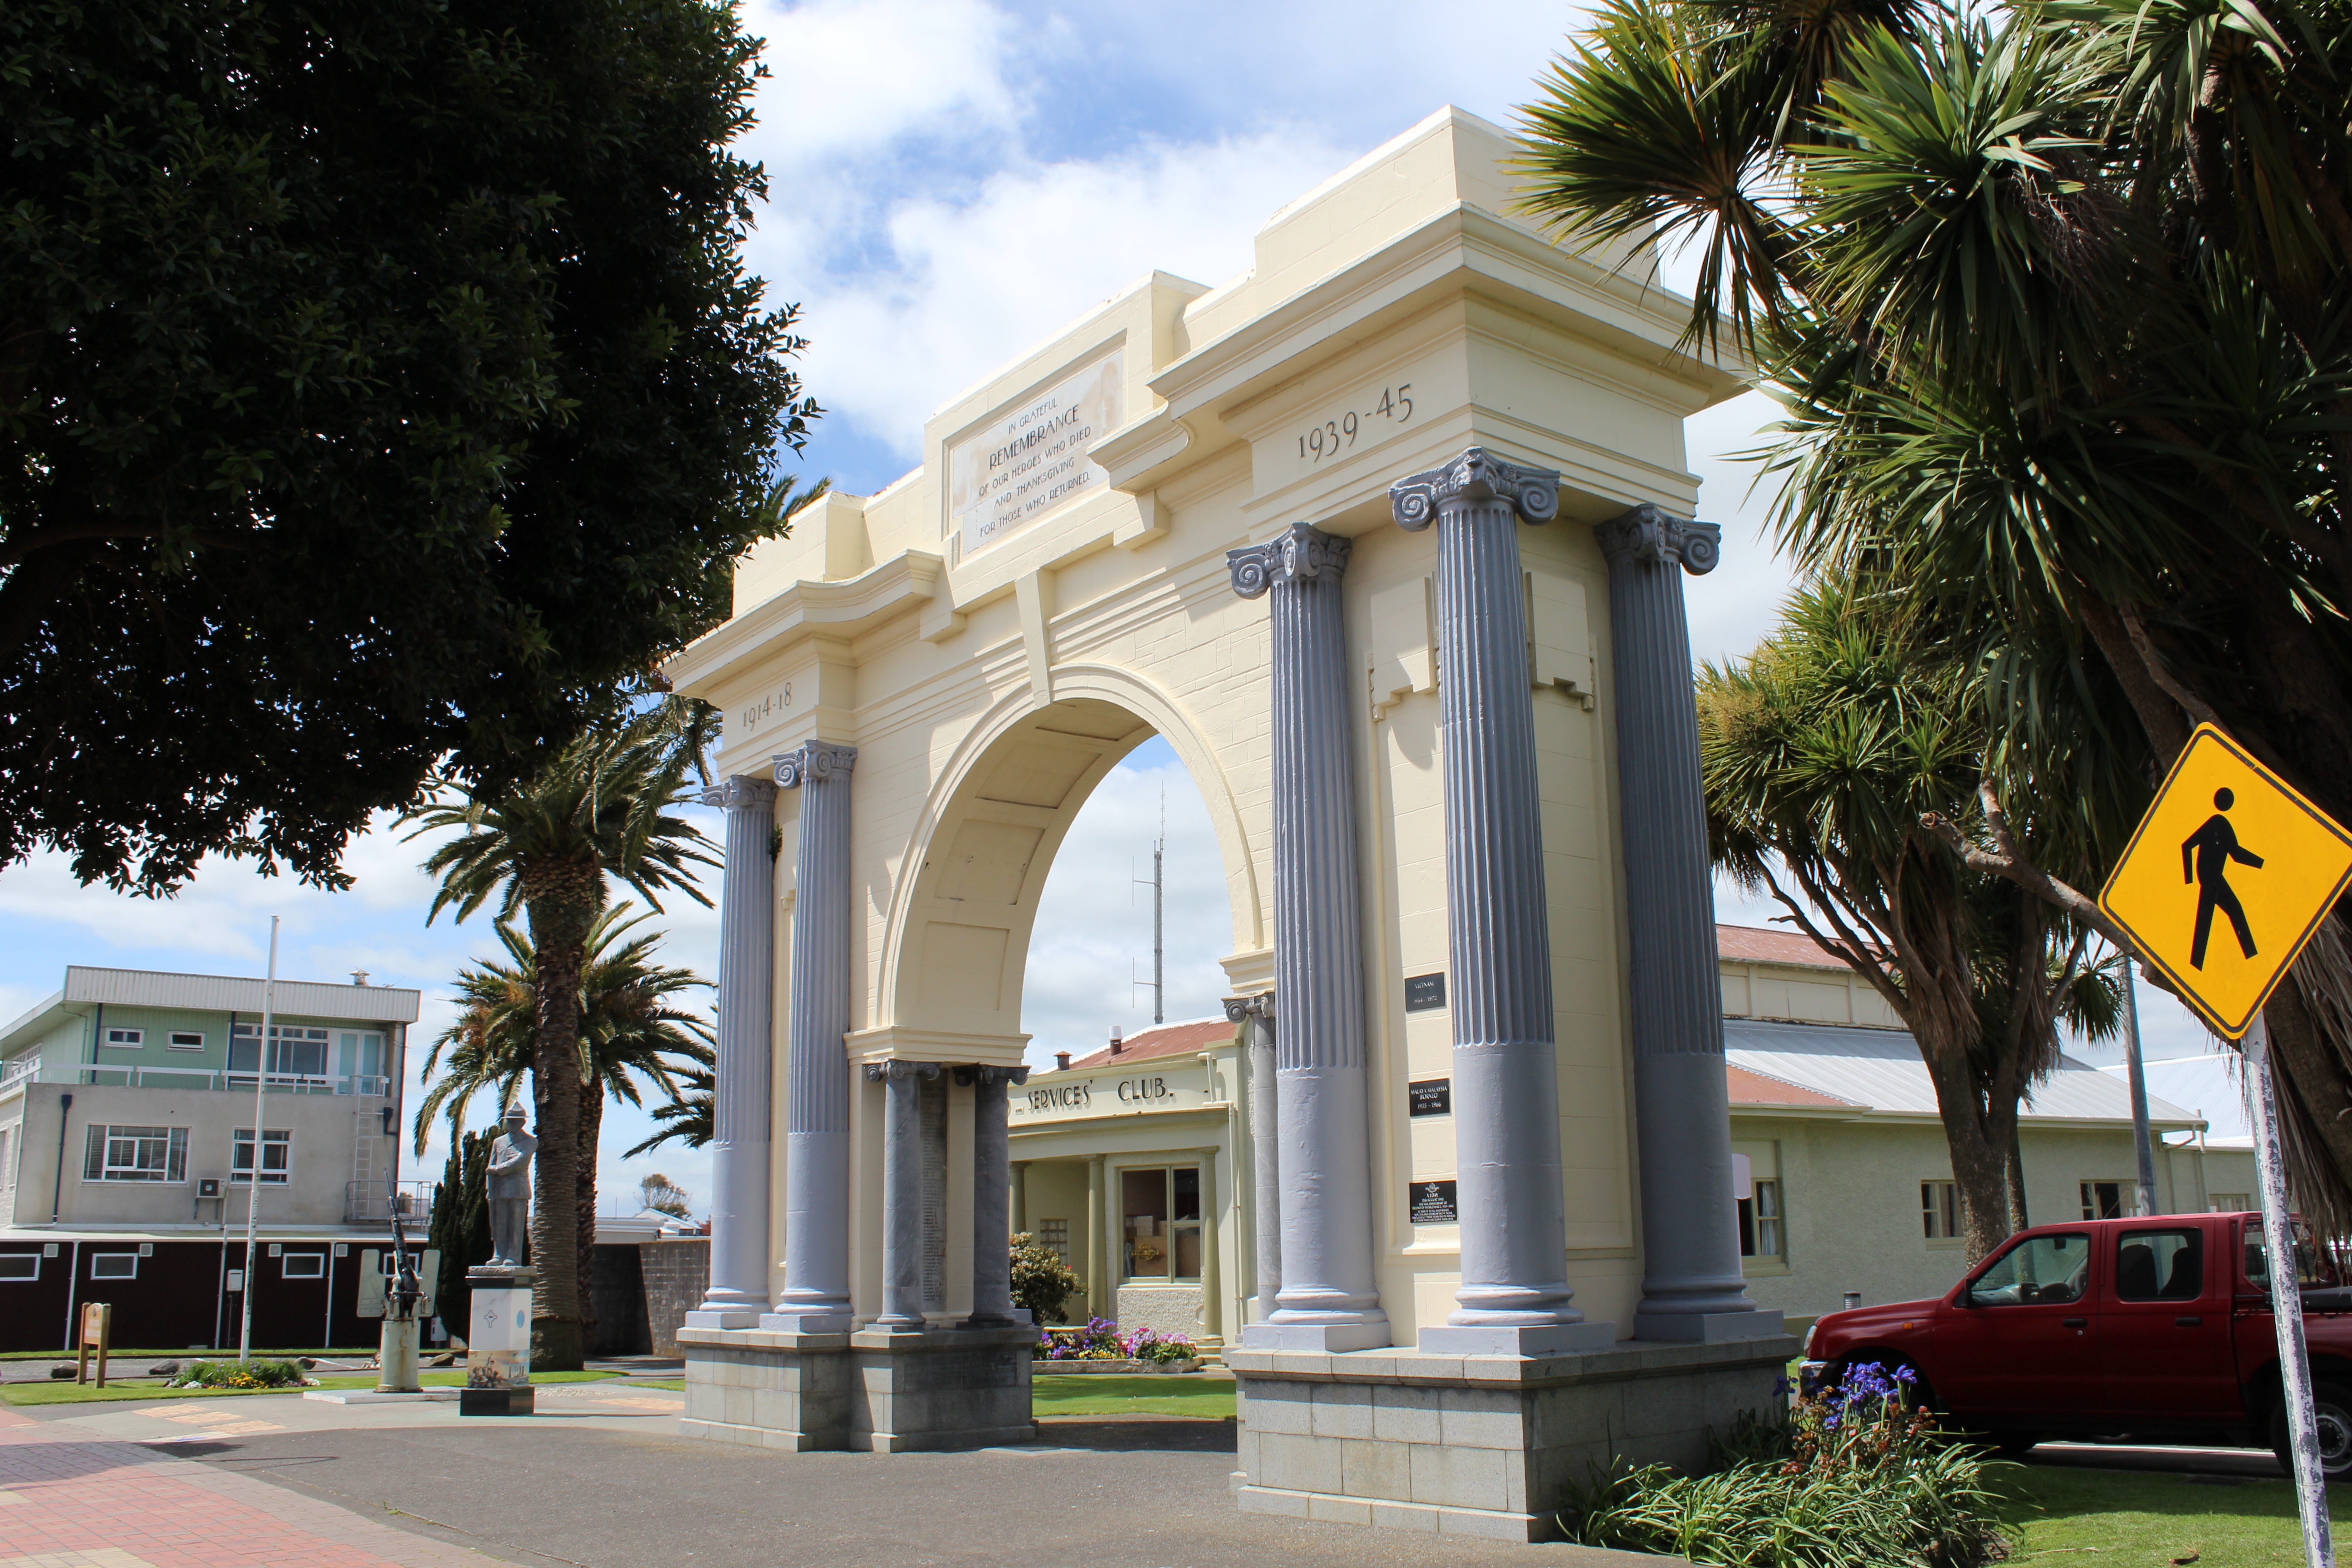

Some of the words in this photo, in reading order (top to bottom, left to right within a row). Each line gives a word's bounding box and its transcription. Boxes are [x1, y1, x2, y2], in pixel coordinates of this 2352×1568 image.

[989, 404, 1079, 470] REMEMBRANCE
[1008, 422, 1016, 435] IN
[1019, 397, 1058, 427] GRATEFUL
[1298, 382, 1413, 463] 1939-45
[979, 482, 990, 497] OF
[992, 473, 1009, 490] OUR
[1011, 455, 1042, 480] HEROES
[1044, 442, 1065, 460] WHO
[1069, 426, 1092, 446] DIED
[994, 491, 1012, 510] AND
[1016, 457, 1074, 496] THANKSGIVING
[980, 522, 995, 538] FOR
[999, 509, 1022, 527] THOSE
[1025, 494, 1046, 512] WHO
[1049, 471, 1091, 500] RETURNED.
[743, 682, 791, 732] 1914-18
[1117, 1078, 1174, 1102] CLUB.
